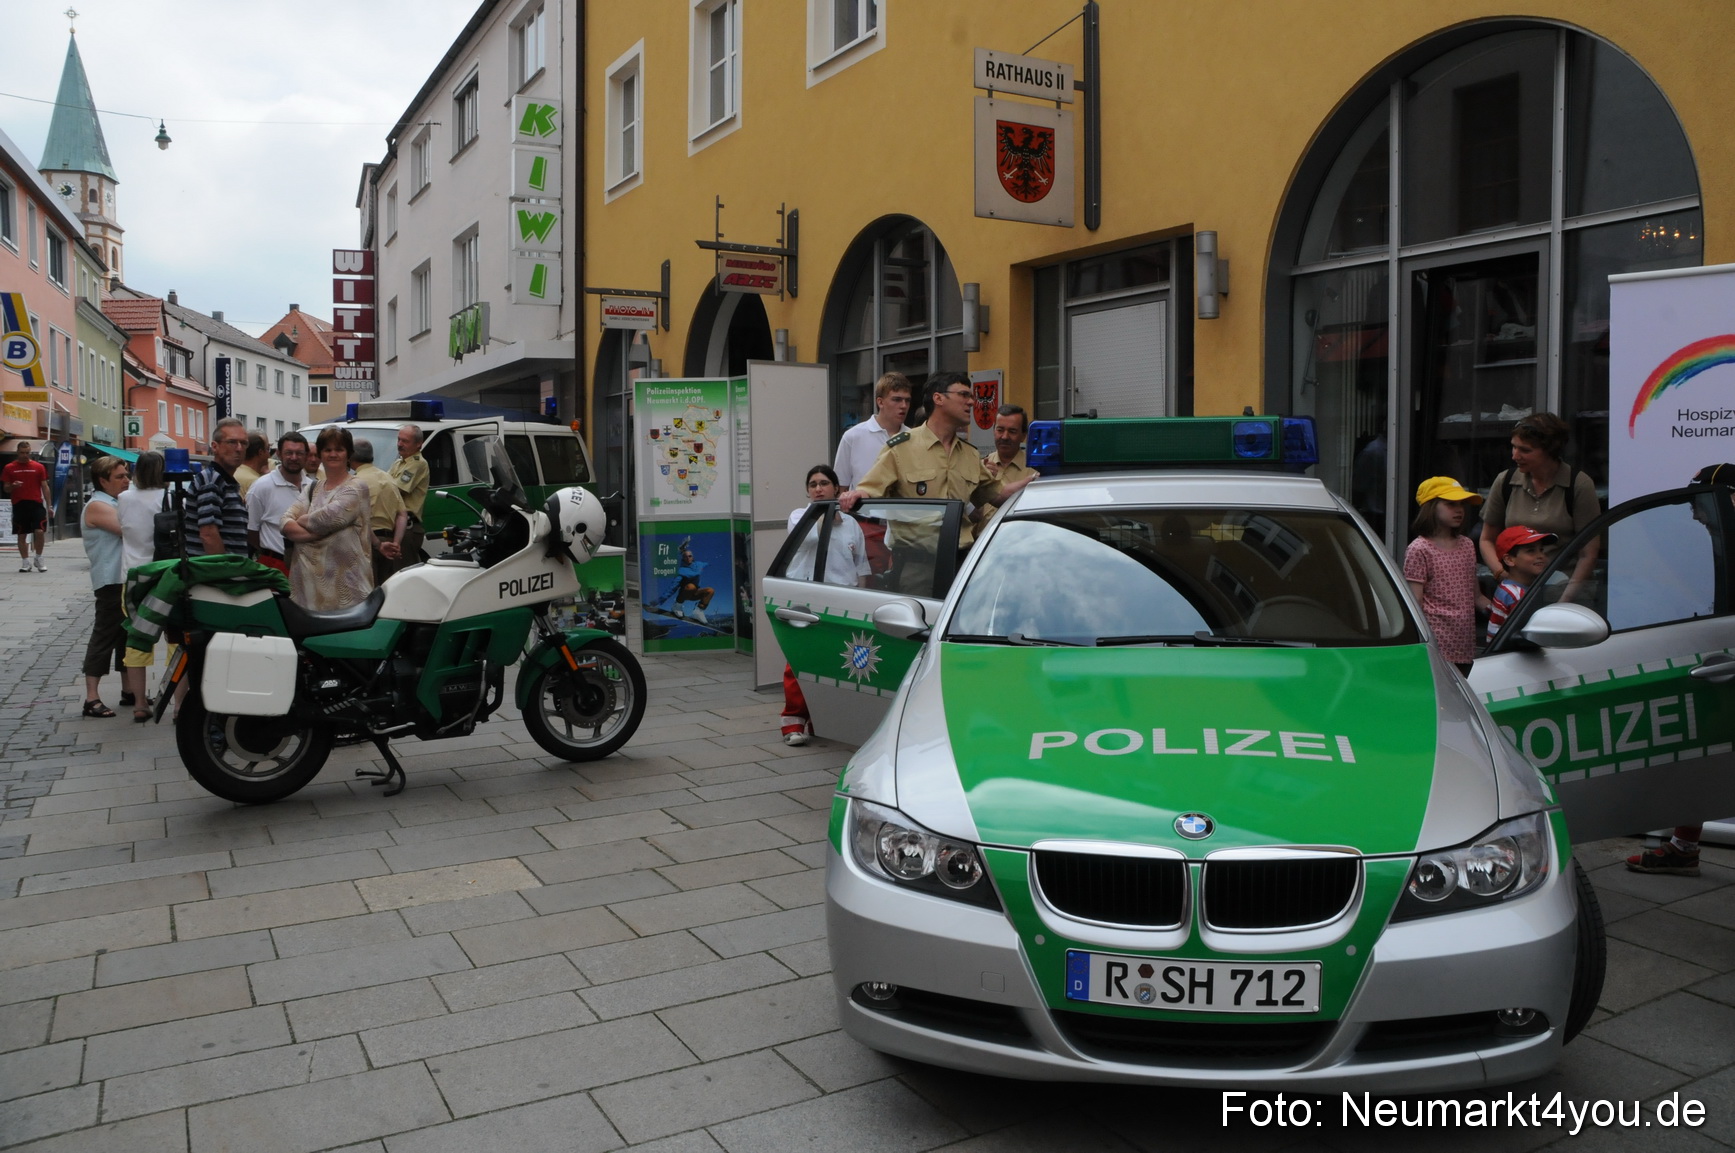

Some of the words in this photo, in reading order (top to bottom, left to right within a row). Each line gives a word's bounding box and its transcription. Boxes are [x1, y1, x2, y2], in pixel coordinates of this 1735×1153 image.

[986, 60, 1053, 88] RATHAUS
[1057, 74, 1064, 90] II
[518, 102, 558, 299] KIWI
[334, 251, 364, 360] WITT
[609, 305, 638, 314] PHOTO
[7, 341, 27, 359] B
[335, 367, 373, 379] WITT
[334, 380, 374, 390] WEIDEN
[646, 387, 702, 396] Polizeiinspektion
[659, 544, 669, 555] Fit
[654, 567, 676, 576] Drogen!
[499, 572, 554, 599] POLIZEI
[1028, 728, 1357, 764] POLIZEI
[1074, 980, 1083, 991] D
[1106, 961, 1130, 999] R
[1161, 966, 1214, 1005] SH
[1230, 969, 1306, 1007] 712
